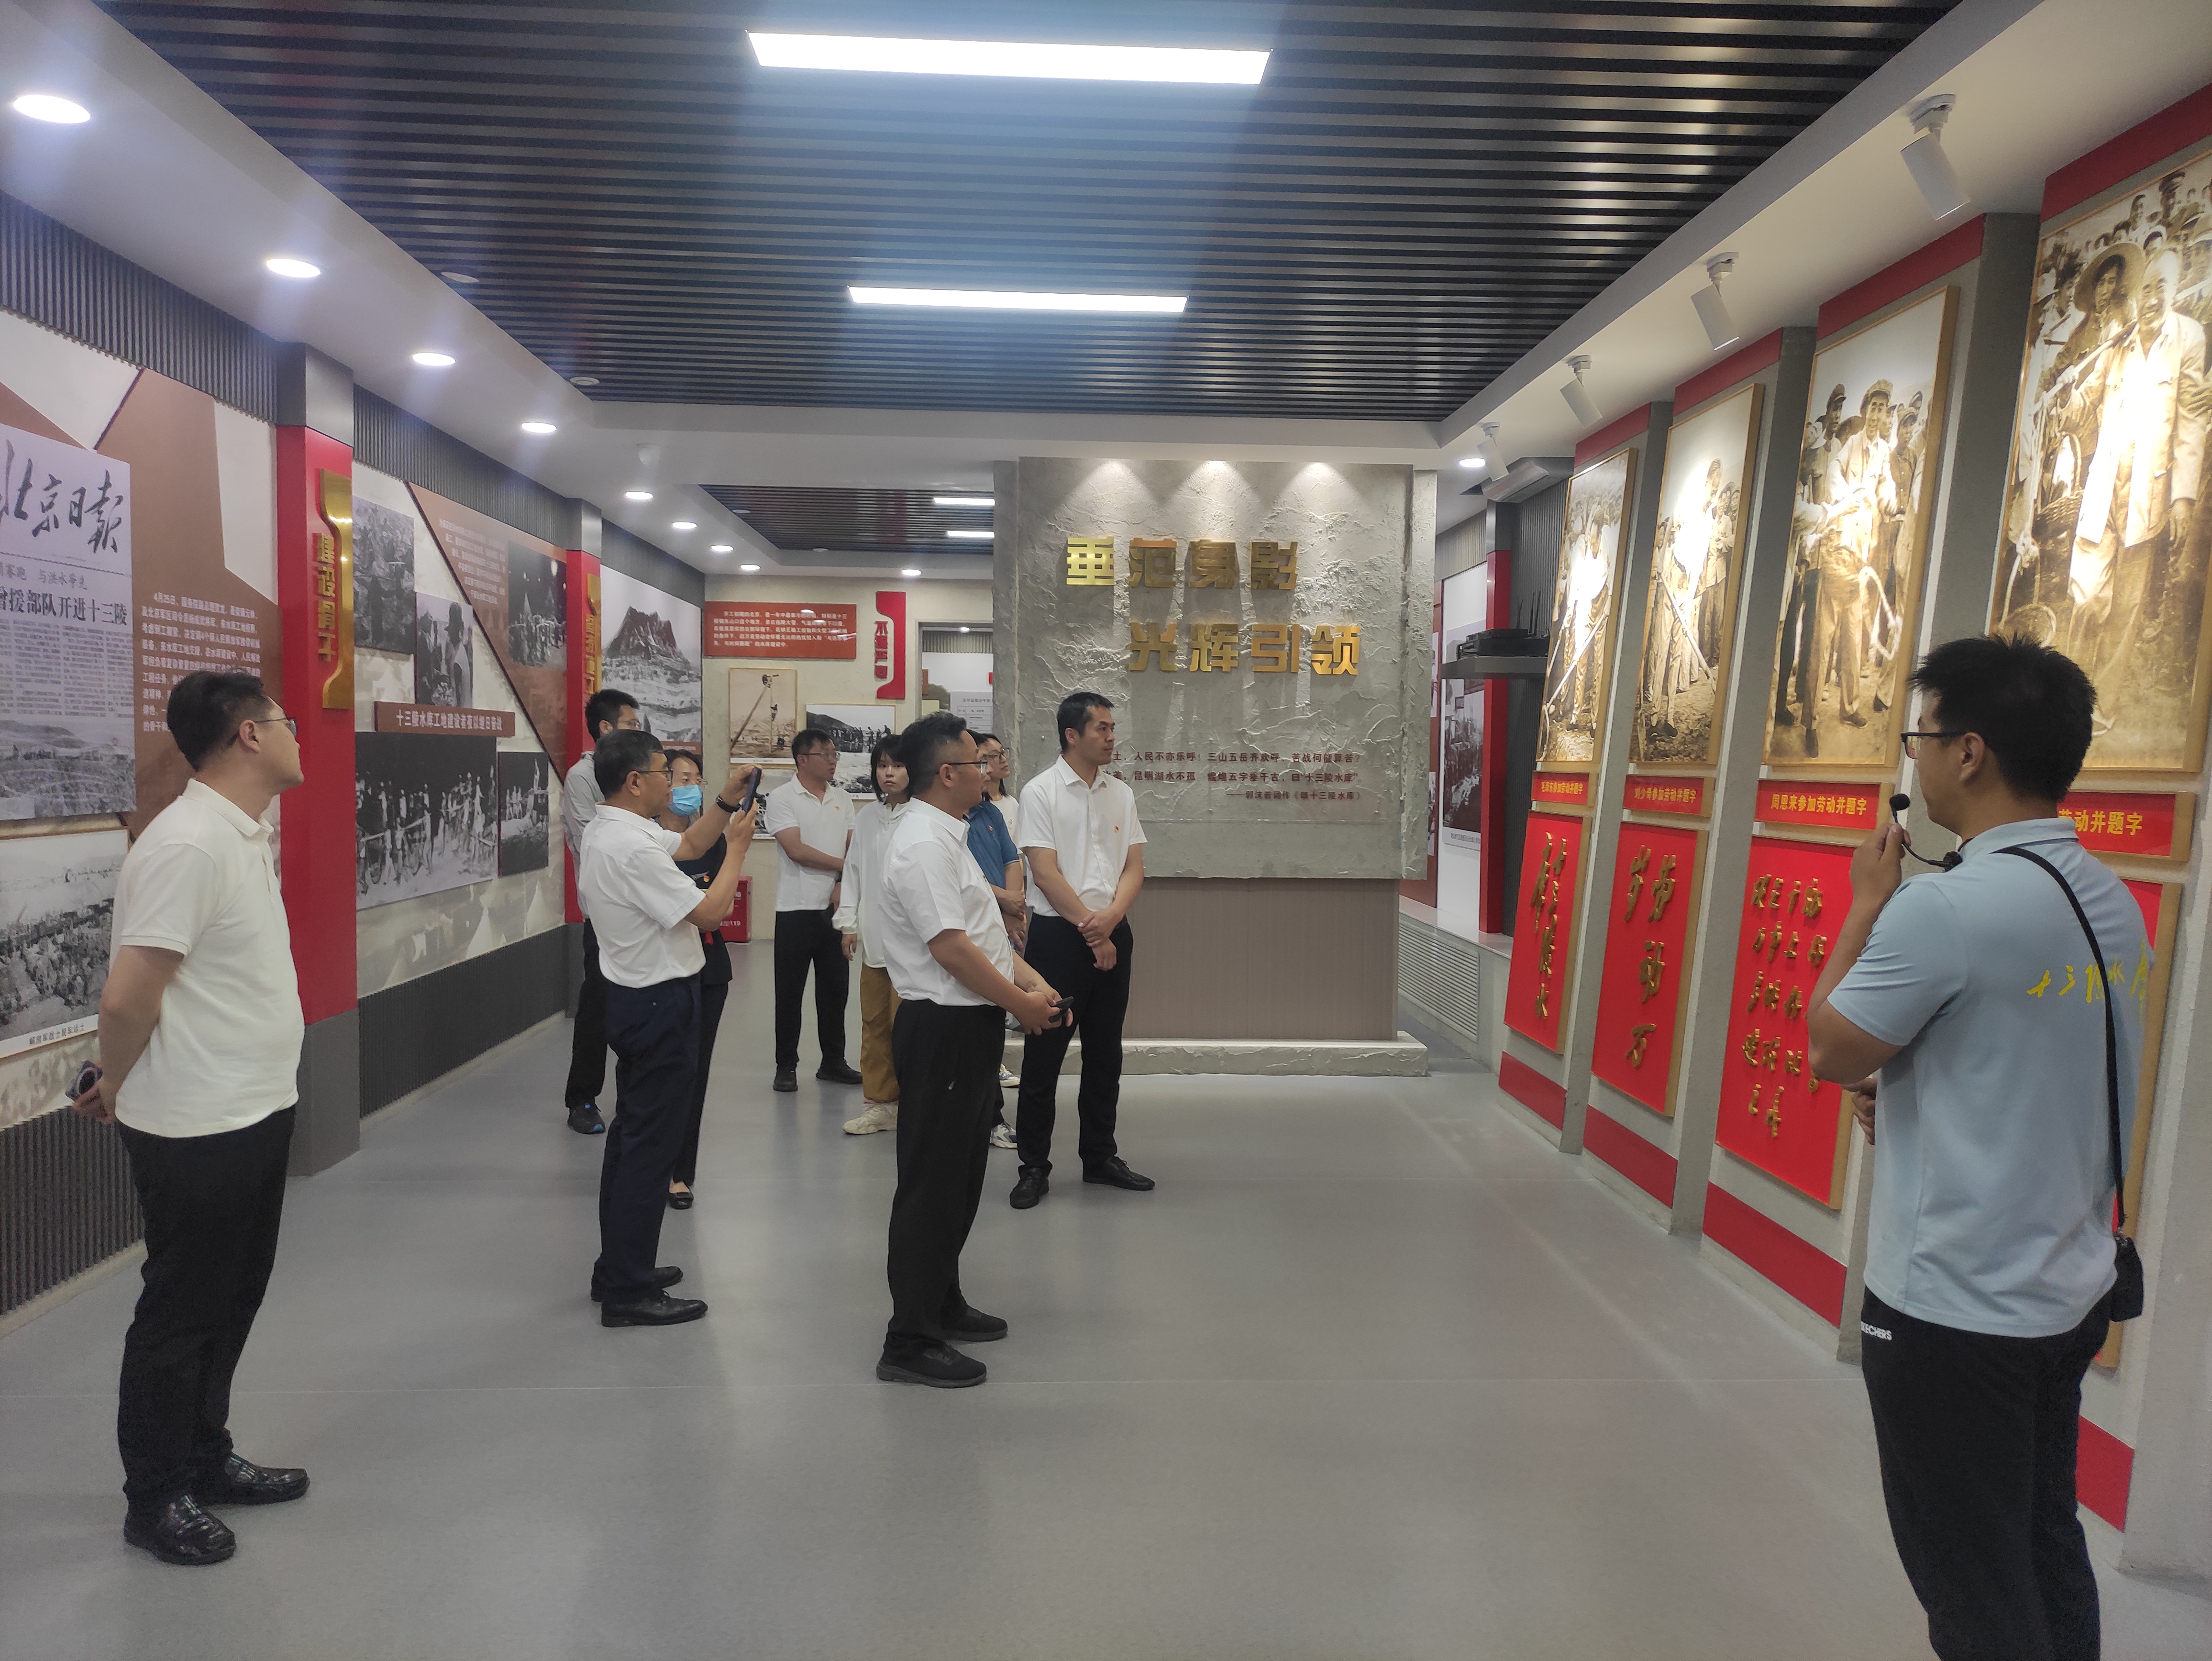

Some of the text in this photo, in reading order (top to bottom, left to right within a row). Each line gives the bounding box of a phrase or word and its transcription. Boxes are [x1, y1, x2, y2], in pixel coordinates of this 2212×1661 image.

[1066, 536, 1298, 590] 垂范身影
[1128, 621, 1360, 675] 光辉引领
[1634, 786, 1696, 803] 刘少奇参加劳动并题字
[1771, 794, 1867, 816] 周恩来参加劳动并题字
